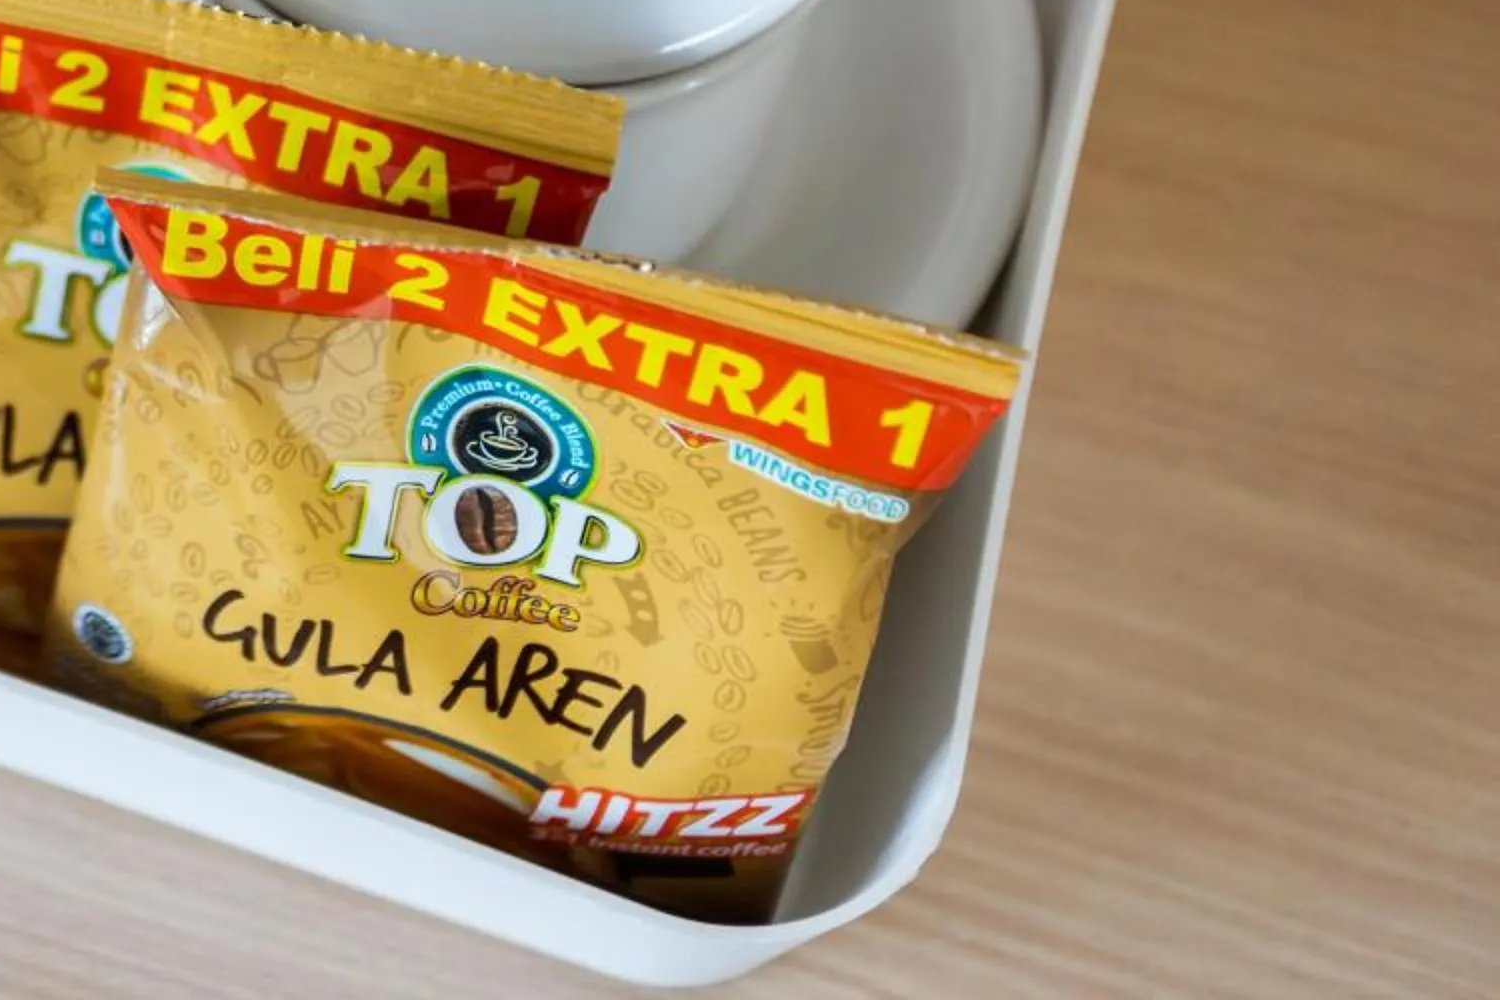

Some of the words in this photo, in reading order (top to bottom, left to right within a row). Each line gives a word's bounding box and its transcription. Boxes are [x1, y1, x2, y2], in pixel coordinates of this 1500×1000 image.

[50, 50, 110, 113] 2
[138, 67, 452, 220] EXTRA
[496, 174, 542, 237] 1
[160, 208, 359, 295] Beli
[386, 253, 450, 311] 2
[482, 277, 833, 448] EXTRA
[880, 399, 935, 469] 1
[420, 378, 496, 430] Premium
[504, 380, 563, 423] Coffee
[558, 420, 592, 470] Blend
[329, 463, 642, 587] TOP
[411, 570, 583, 632] Coffee
[202, 588, 414, 697] GULA
[438, 634, 688, 769] AREN
[529, 788, 806, 838] HITZZ
